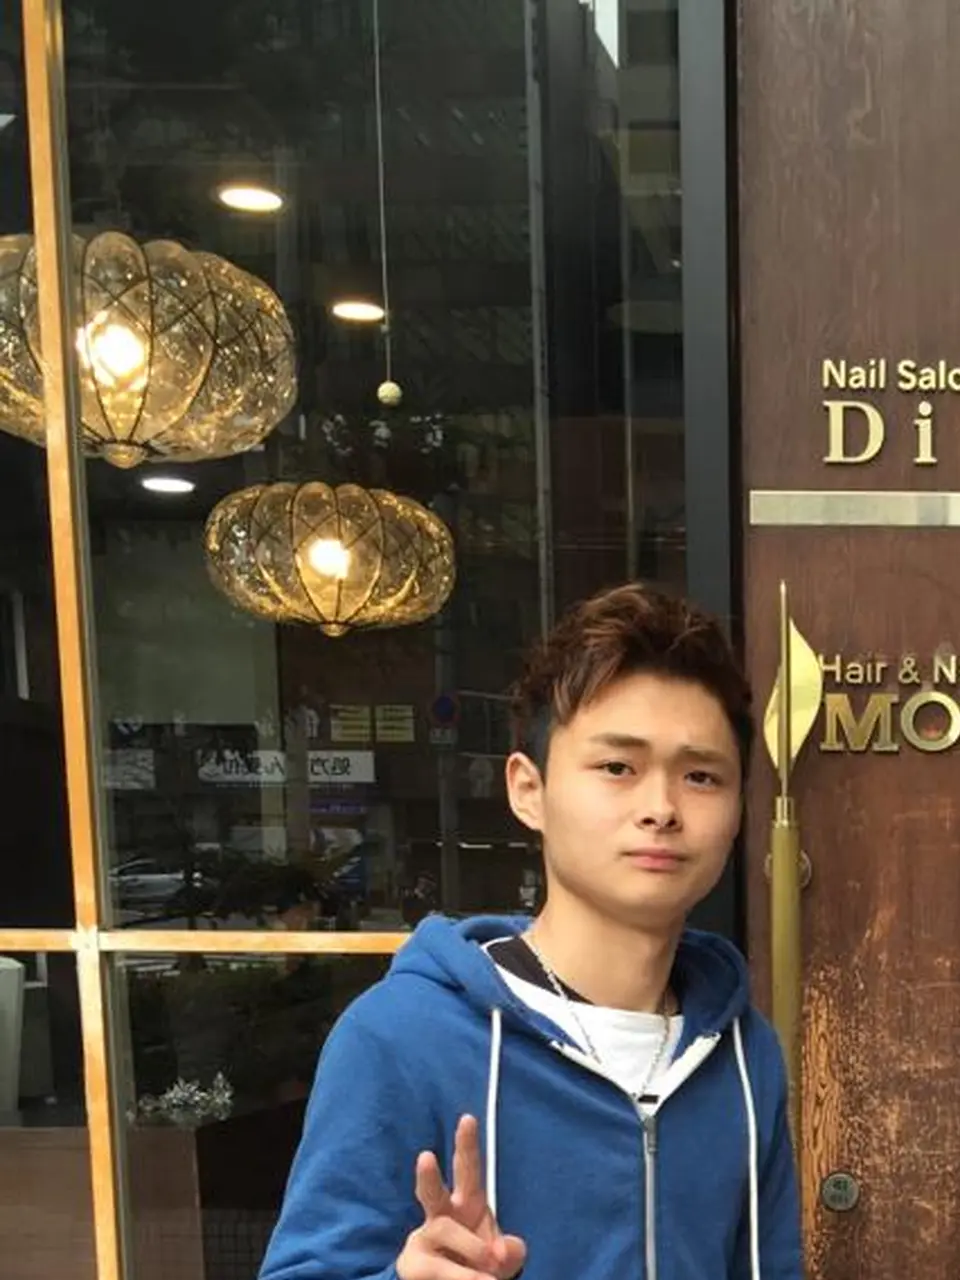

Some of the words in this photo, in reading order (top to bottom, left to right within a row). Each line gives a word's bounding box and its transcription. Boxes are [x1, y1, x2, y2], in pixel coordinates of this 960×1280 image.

[822, 358, 886, 389] Nail
[818, 653, 888, 684] Hair
[898, 656, 920, 684] &
